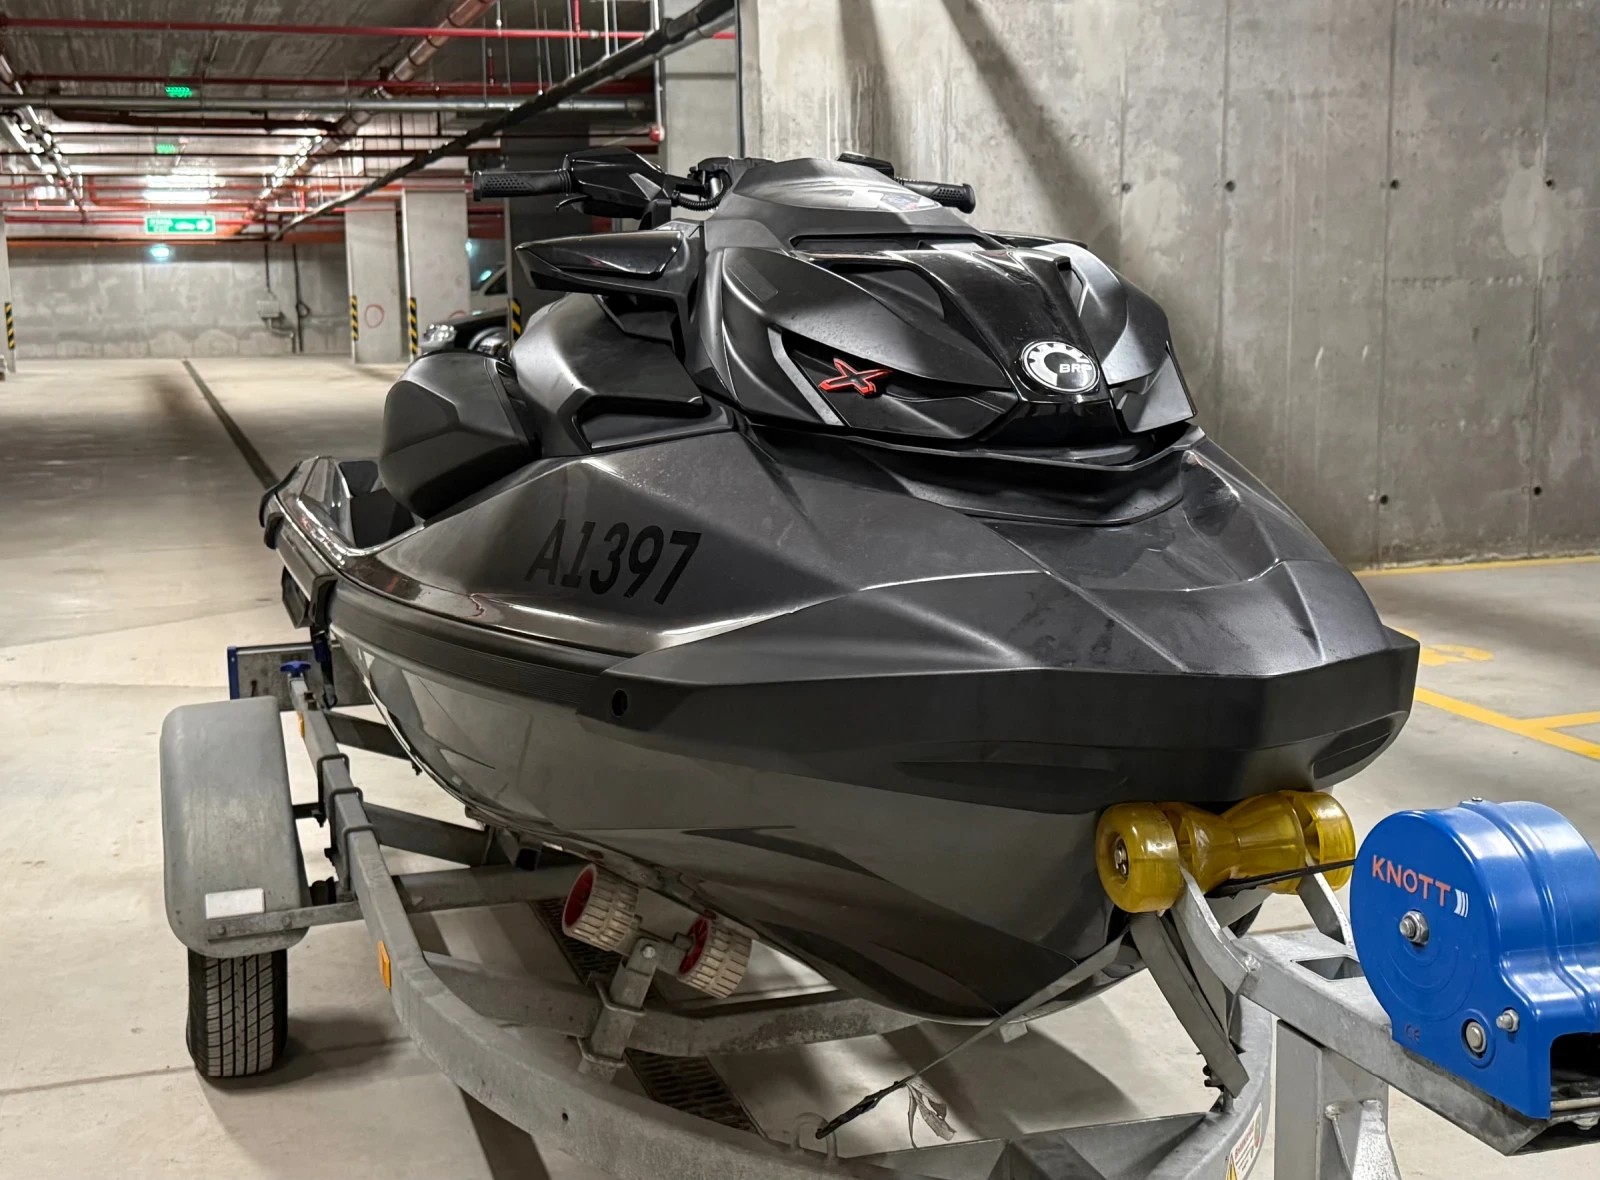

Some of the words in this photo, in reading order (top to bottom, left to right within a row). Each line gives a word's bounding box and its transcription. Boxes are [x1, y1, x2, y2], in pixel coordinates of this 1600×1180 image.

[1059, 363, 1093, 374] BRP
[524, 519, 702, 605] A1397
[1372, 854, 1451, 907] KNOTT
